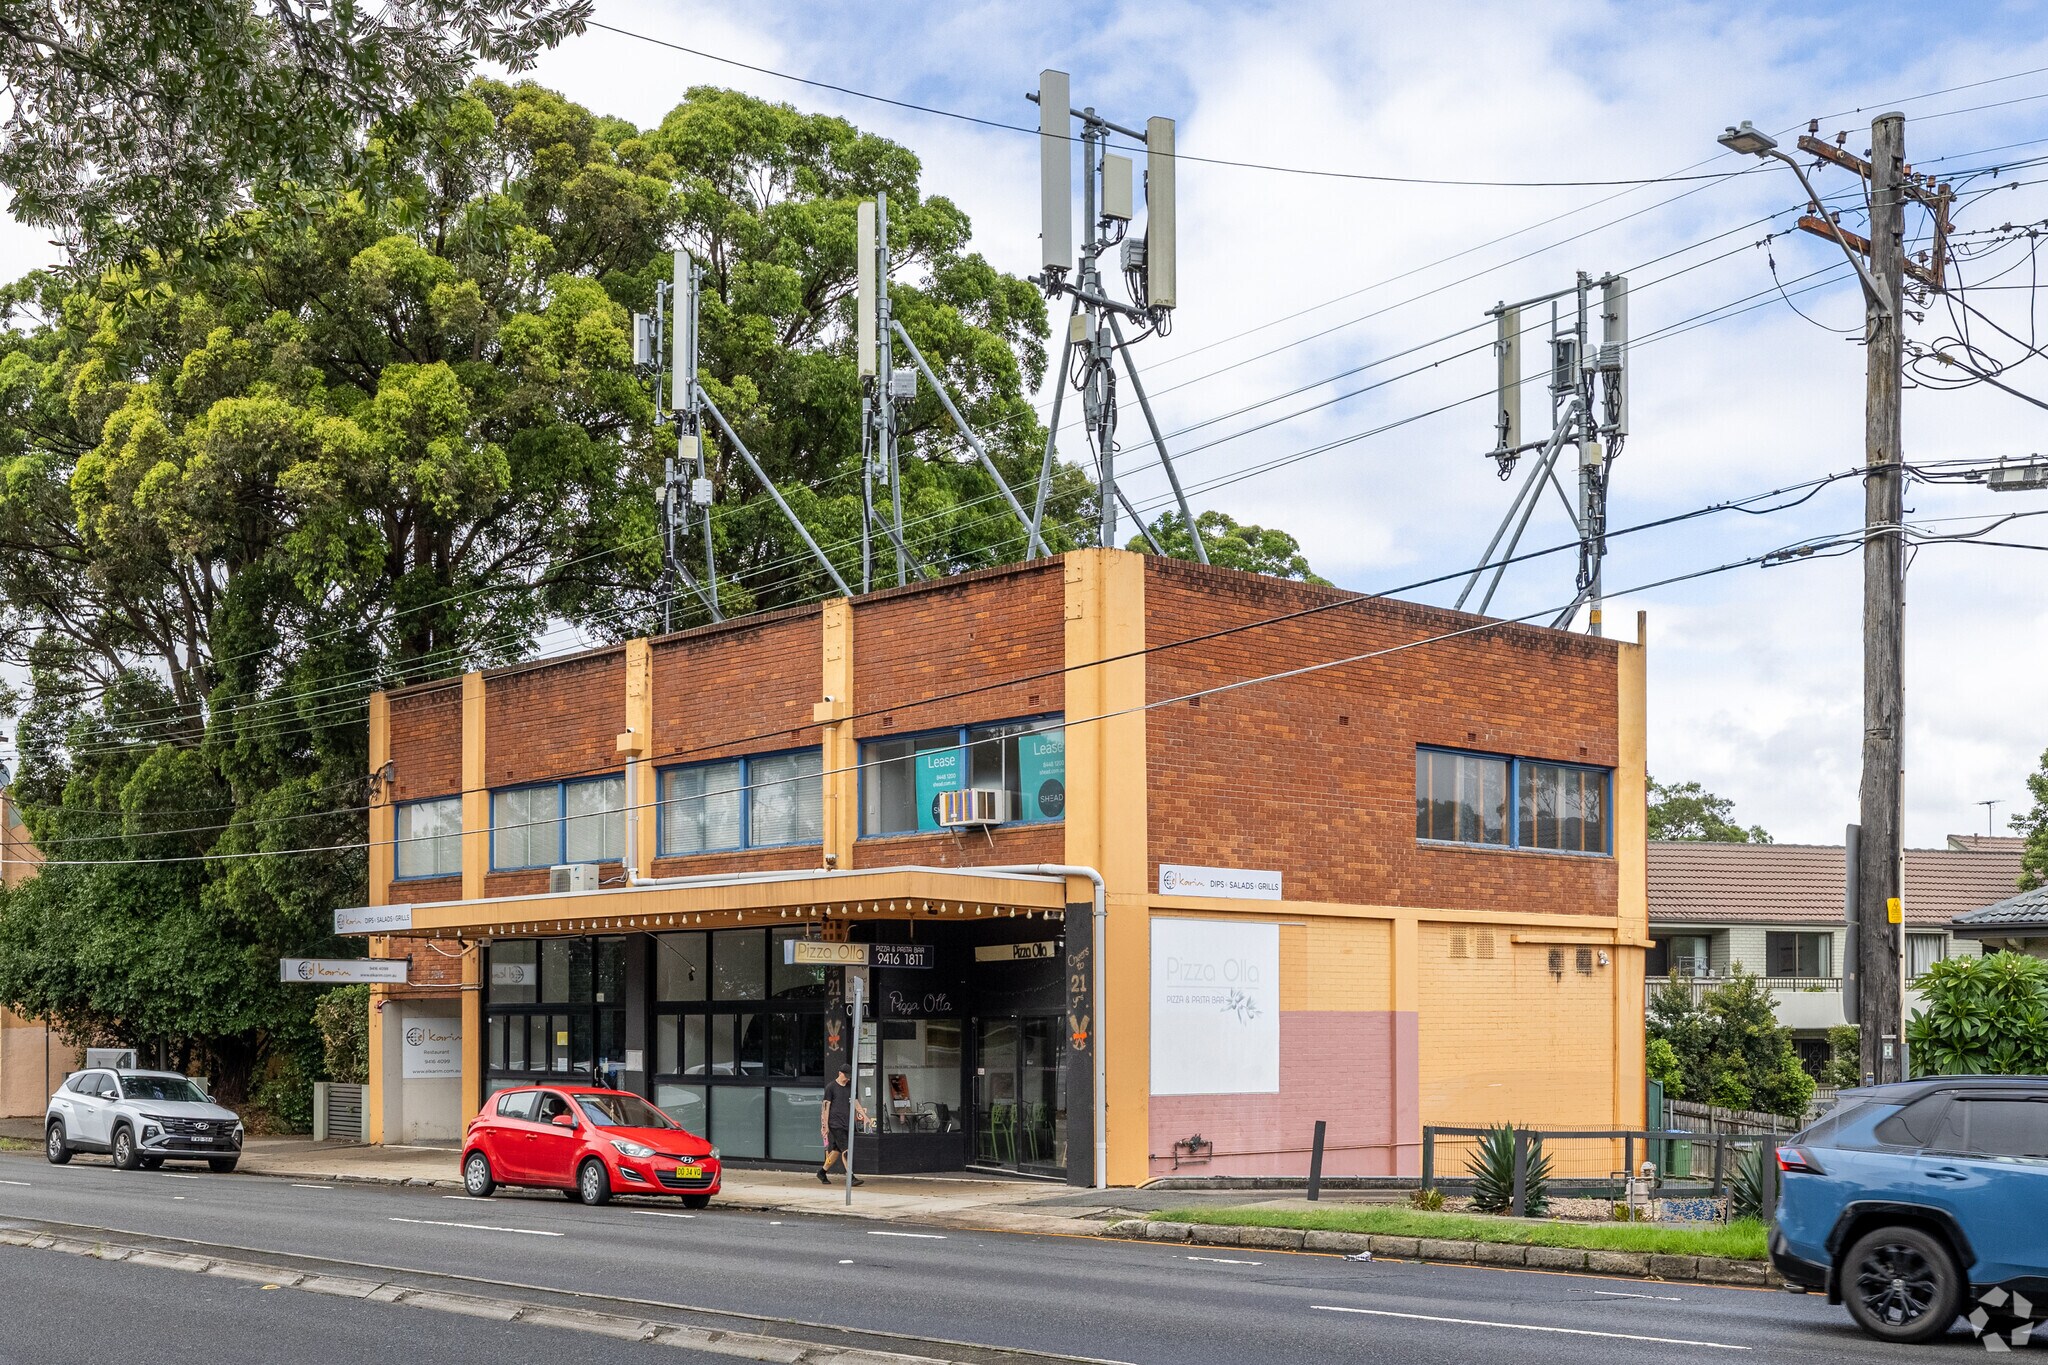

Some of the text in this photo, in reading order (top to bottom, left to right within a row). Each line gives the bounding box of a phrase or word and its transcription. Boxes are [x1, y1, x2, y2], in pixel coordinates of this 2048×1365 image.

[1033, 741, 1064, 756] Lease
[928, 754, 956, 769] Lease
[1040, 793, 1064, 804] SHEAD
[1179, 872, 1205, 887] karim
[1210, 880, 1225, 889] DIPS
[1229, 880, 1255, 890] SALADS
[1257, 882, 1279, 891] GRILLS
[376, 915, 394, 923] SALADS
[395, 914, 410, 922] GRILLS
[798, 943, 865, 960] Pizza Olla
[1013, 943, 1047, 958] Pizza Olla
[877, 952, 924, 966] 9416 1811
[1076, 962, 1084, 971] to
[317, 962, 351, 977] karim
[1167, 956, 1260, 983] Pizza Olla
[828, 979, 841, 996] 21
[1071, 975, 1087, 993] 21
[923, 993, 952, 1013] Olla
[1072, 995, 1084, 1009] yrs
[1166, 995, 1184, 1004] PIZZA
[1191, 995, 1210, 1004] PASTA
[1211, 996, 1225, 1004] BAR
[1884, 1045, 1892, 1056] H
